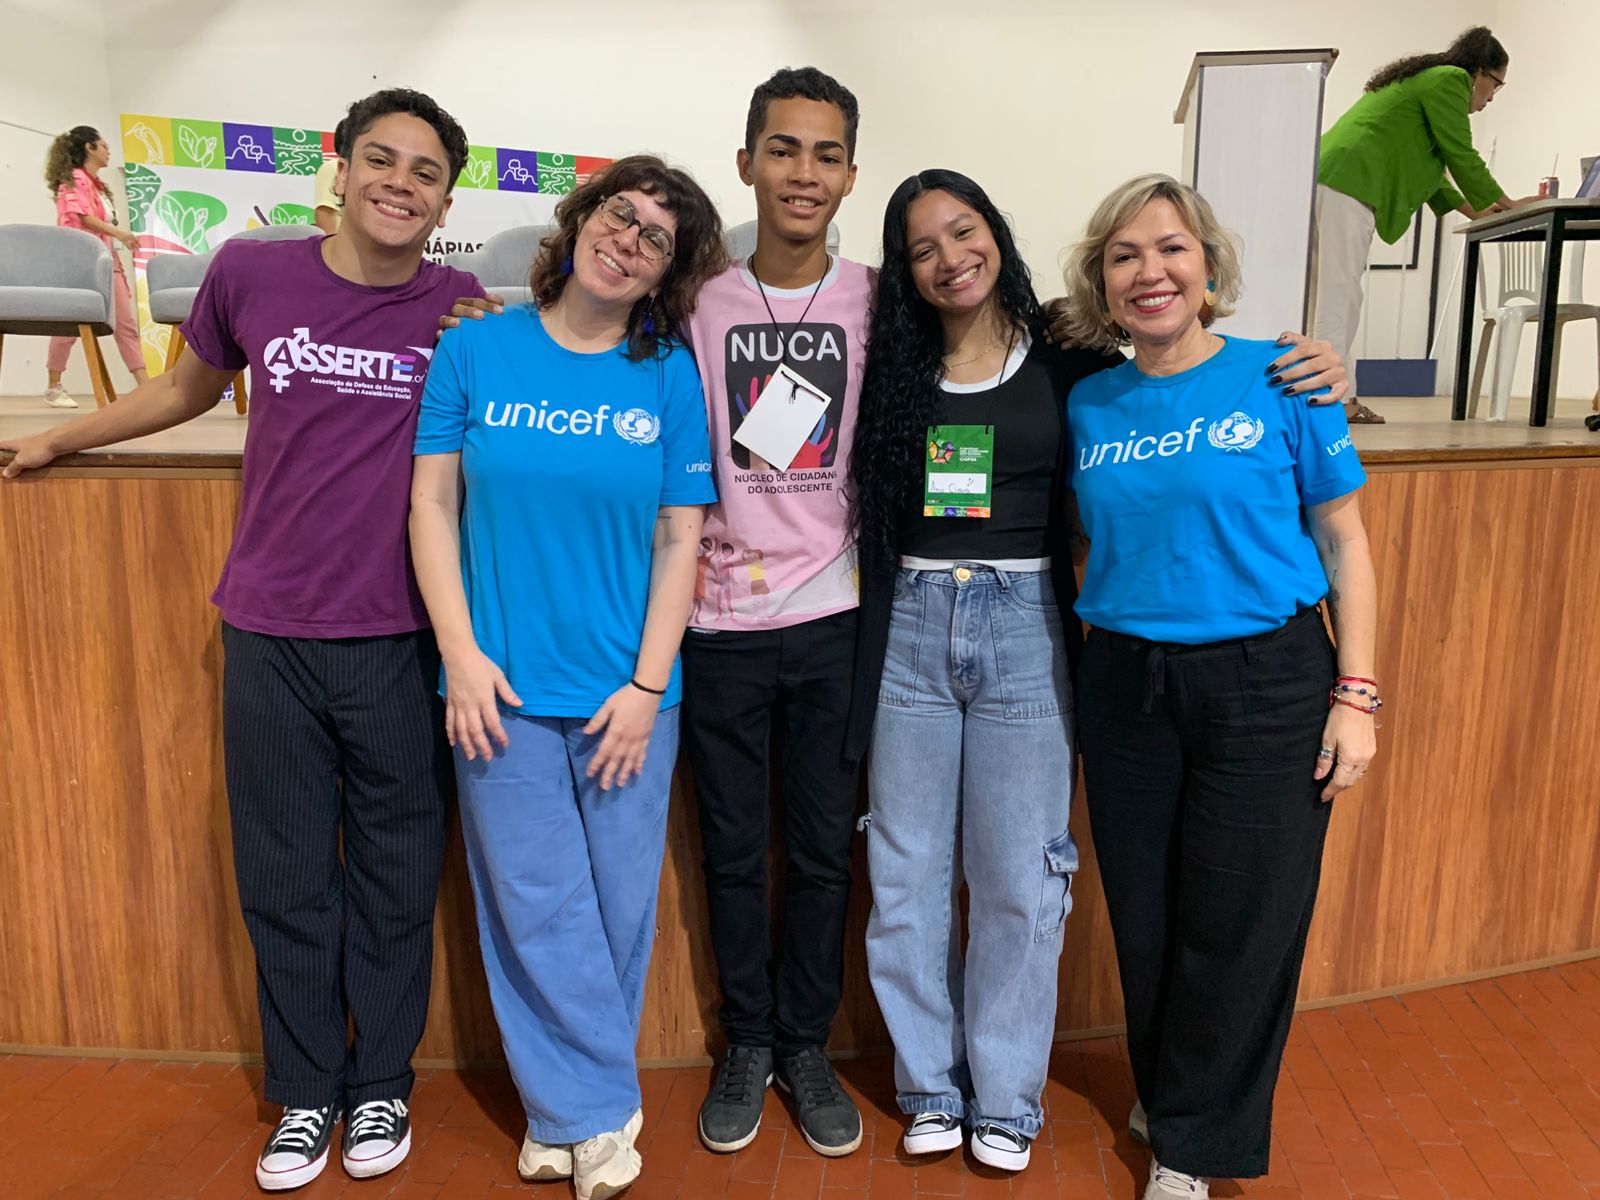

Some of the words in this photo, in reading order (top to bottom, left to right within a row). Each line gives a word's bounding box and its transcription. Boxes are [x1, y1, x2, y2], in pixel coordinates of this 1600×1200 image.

[731, 330, 842, 362] NUCA
[484, 399, 611, 436] unicef
[1079, 417, 1205, 471] unicef
[734, 472, 774, 483] NÚCLEO
[776, 473, 788, 482] DE
[748, 485, 763, 494] DO
[764, 483, 833, 494] ADOLESCENTE
